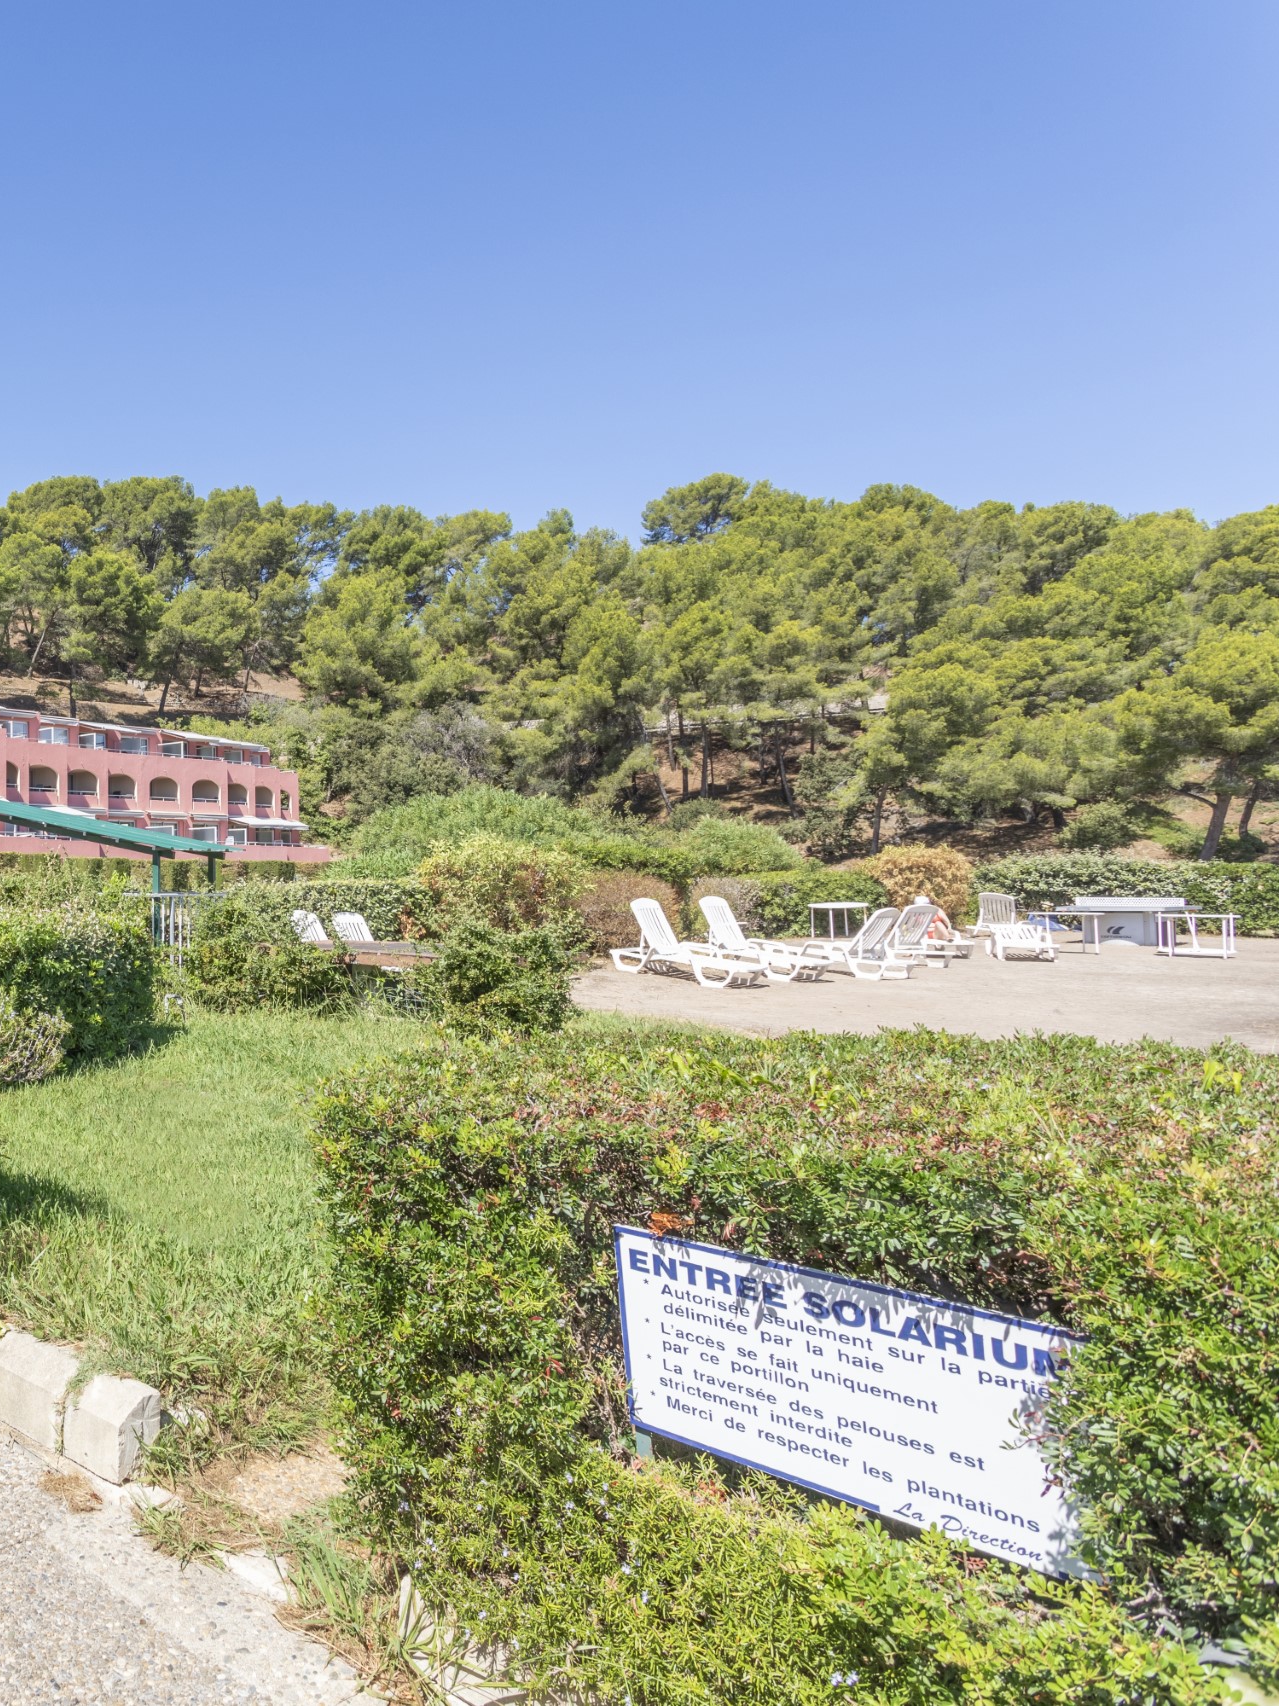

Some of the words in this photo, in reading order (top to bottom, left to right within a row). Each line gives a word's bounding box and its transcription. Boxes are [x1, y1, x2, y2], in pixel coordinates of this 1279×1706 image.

[629, 1248, 787, 1310] ENTREE
[660, 1322, 725, 1351] L'accès
[737, 1347, 758, 1360] se
[769, 1353, 799, 1373] fait
[811, 1368, 939, 1414] uniquement
[661, 1284, 750, 1318] Autorisée
[762, 1313, 873, 1351] seulement
[888, 1346, 926, 1365] sur
[941, 1357, 961, 1375] la
[978, 1370, 1051, 1401] partie
[662, 1340, 689, 1355] par
[700, 1352, 720, 1365] ce
[731, 1360, 809, 1392] portillon
[664, 1303, 748, 1335] délimitée
[760, 1330, 793, 1347] par
[806, 1340, 823, 1356] la
[838, 1349, 884, 1373] haie
[659, 1376, 758, 1417] strictement
[770, 1410, 853, 1448] interdite
[662, 1358, 683, 1375] La
[693, 1369, 777, 1405] traversée
[789, 1400, 824, 1420] des
[837, 1415, 935, 1455] pelouses
[949, 1451, 985, 1471] est
[666, 1395, 713, 1422] Merci
[724, 1417, 746, 1432] de
[758, 1428, 849, 1467] respecter
[862, 1461, 893, 1483] les
[907, 1478, 1041, 1533] plantations
[893, 1503, 926, 1522] La
[940, 1514, 1043, 1561] Direction
